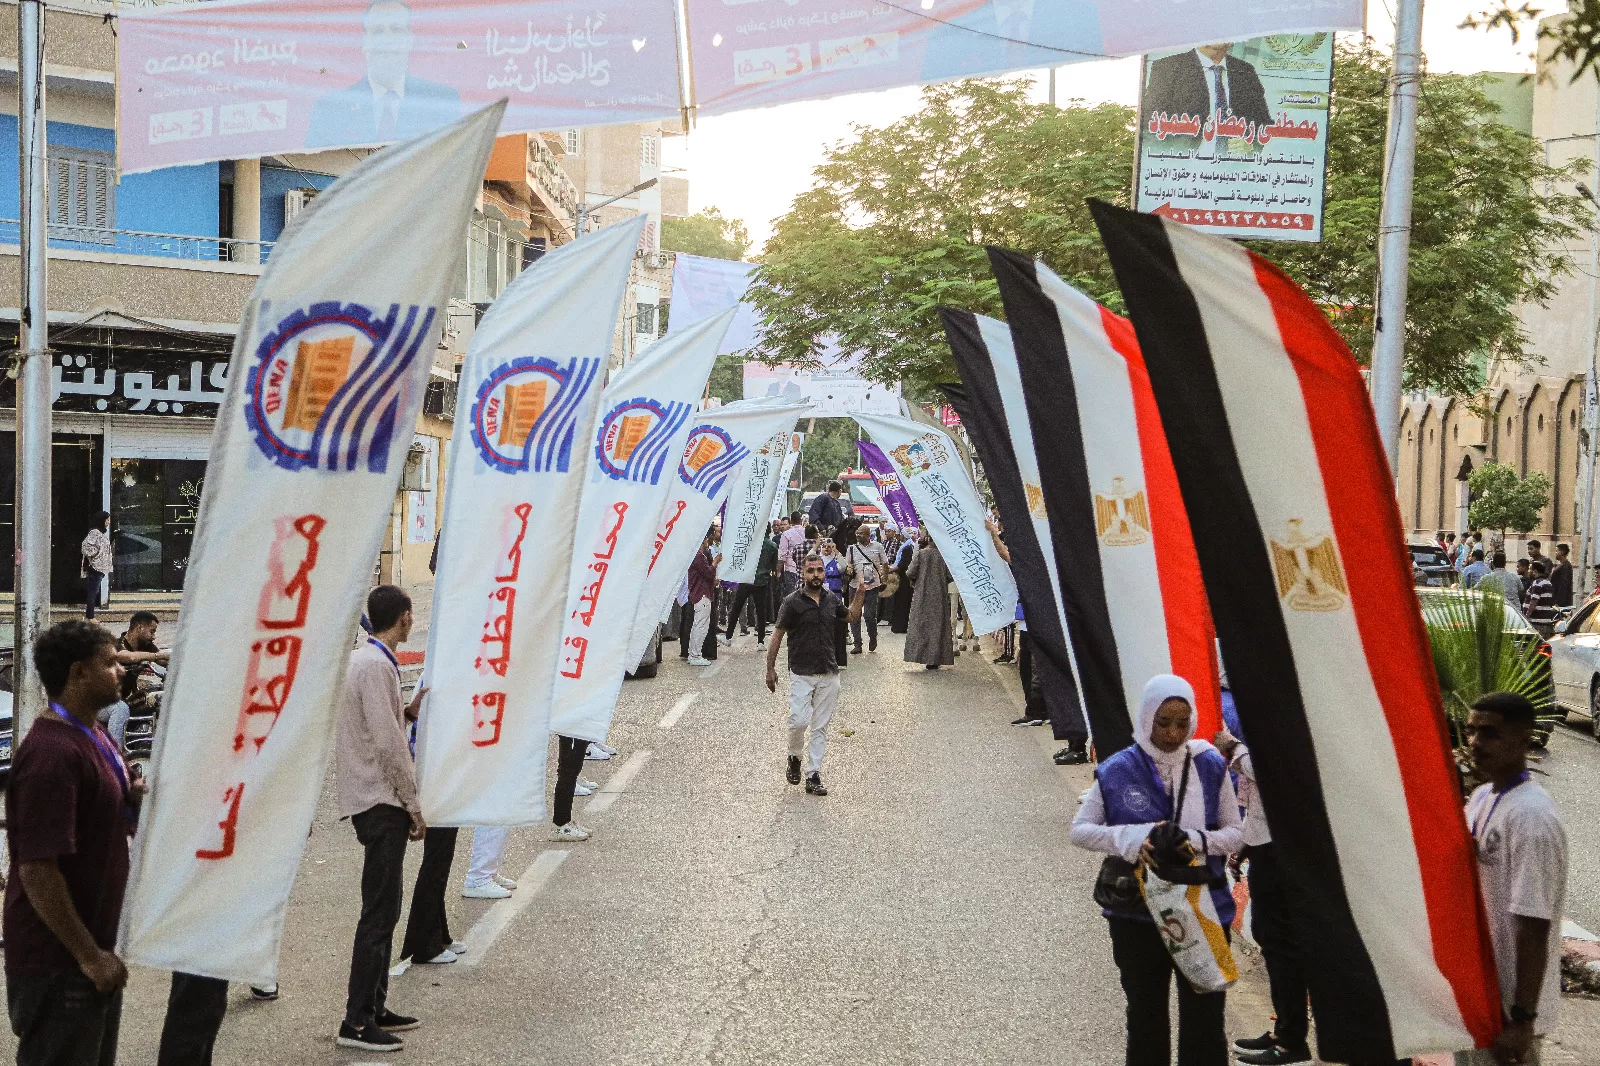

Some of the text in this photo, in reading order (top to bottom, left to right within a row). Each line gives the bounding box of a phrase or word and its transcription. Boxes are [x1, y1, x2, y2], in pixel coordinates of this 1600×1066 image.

[1278, 94, 1320, 105] المستشار
[1148, 110, 1201, 140] محمود
[1203, 107, 1255, 144] رمضان
[1147, 147, 1193, 162] العليا
[1172, 170, 1190, 182] حقوق
[1241, 171, 1271, 184] العلاقات
[1144, 185, 1176, 201] الدولية
[1177, 188, 1212, 201] العلاقات
[1280, 192, 1311, 206] وحاصل
[266, 358, 289, 415] QENA
[560, 501, 629, 680] محافظة قنا
[472, 502, 533, 748] محافظة قنا
